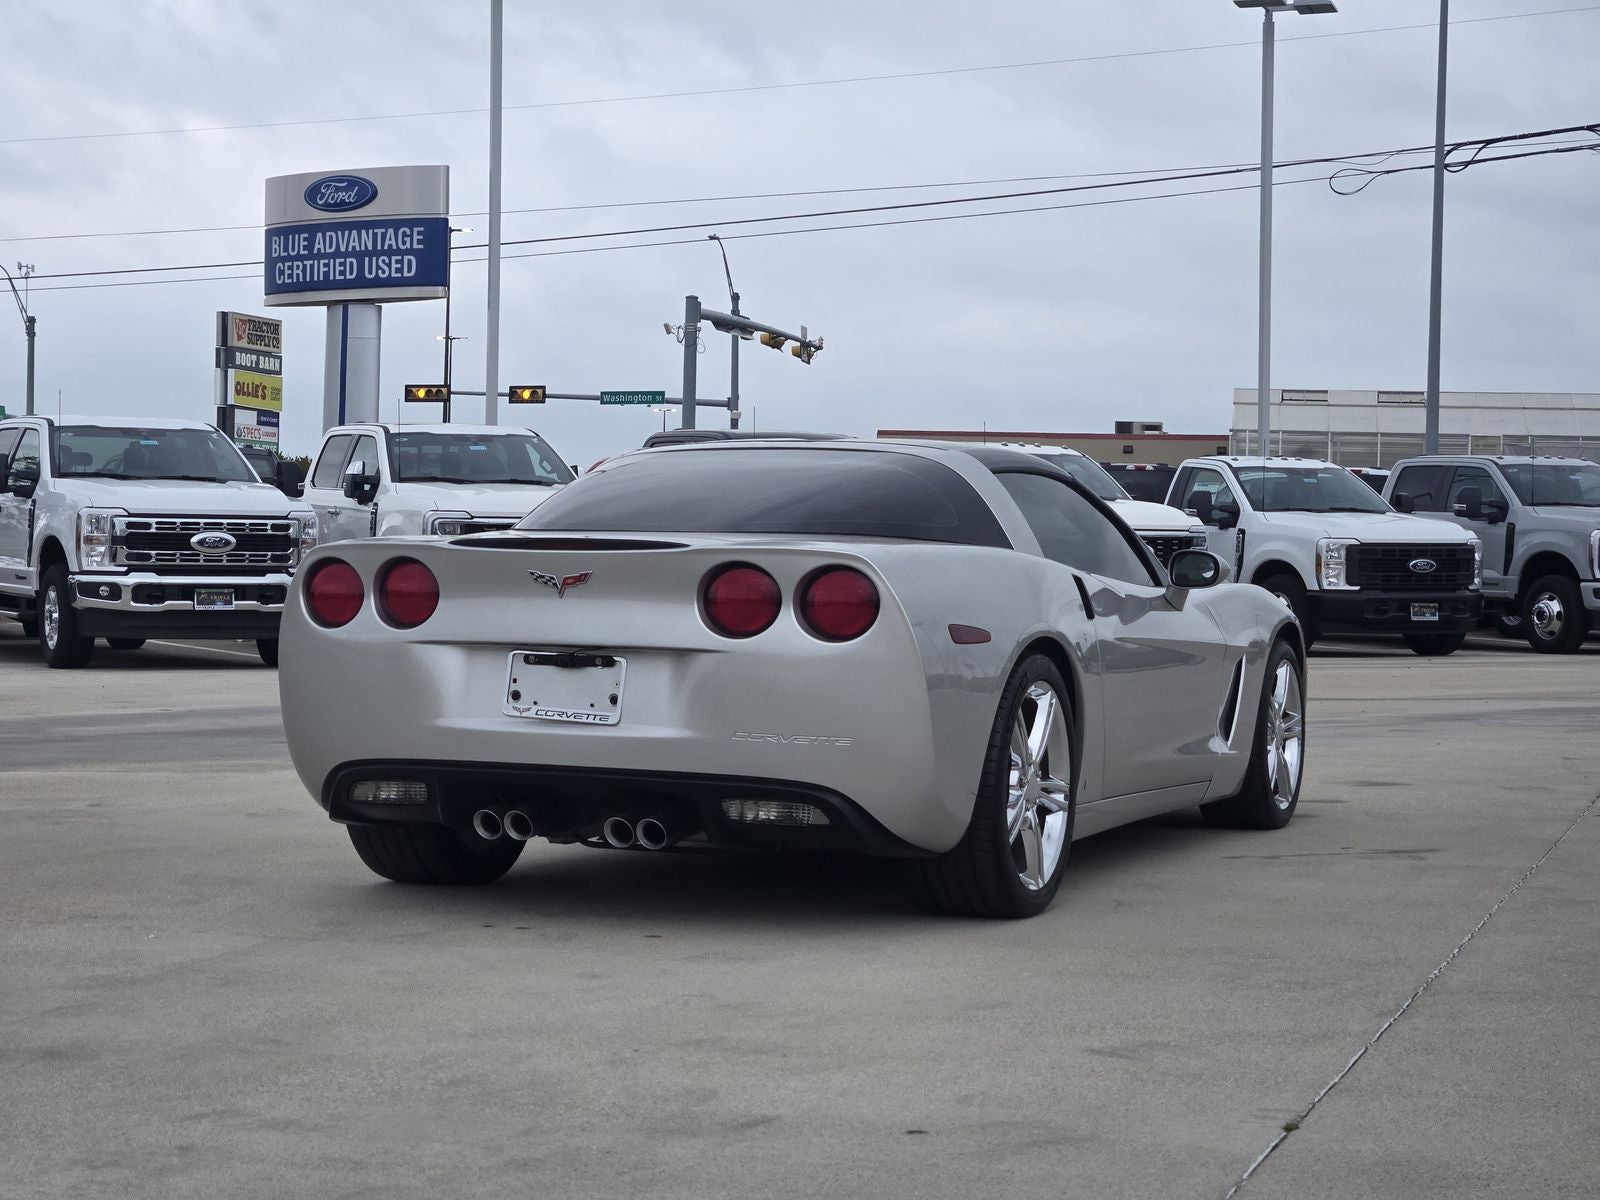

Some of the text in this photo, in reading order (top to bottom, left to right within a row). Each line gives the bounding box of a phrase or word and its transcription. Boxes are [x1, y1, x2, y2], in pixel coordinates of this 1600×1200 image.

[317, 181, 359, 205] Ford
[271, 226, 425, 257] BLUE ADVANTAGE
[275, 255, 417, 284] CERTIFIED USED
[247, 319, 280, 336] TRACTOR
[247, 332, 271, 347] SUPPLY
[235, 351, 280, 371] BOOT BARN
[603, 393, 653, 403] Washington
[243, 426, 262, 439] SPEC'S
[203, 537, 226, 547] Ford
[535, 708, 611, 722] CORVETTE
[731, 731, 854, 746] CORVETTE
